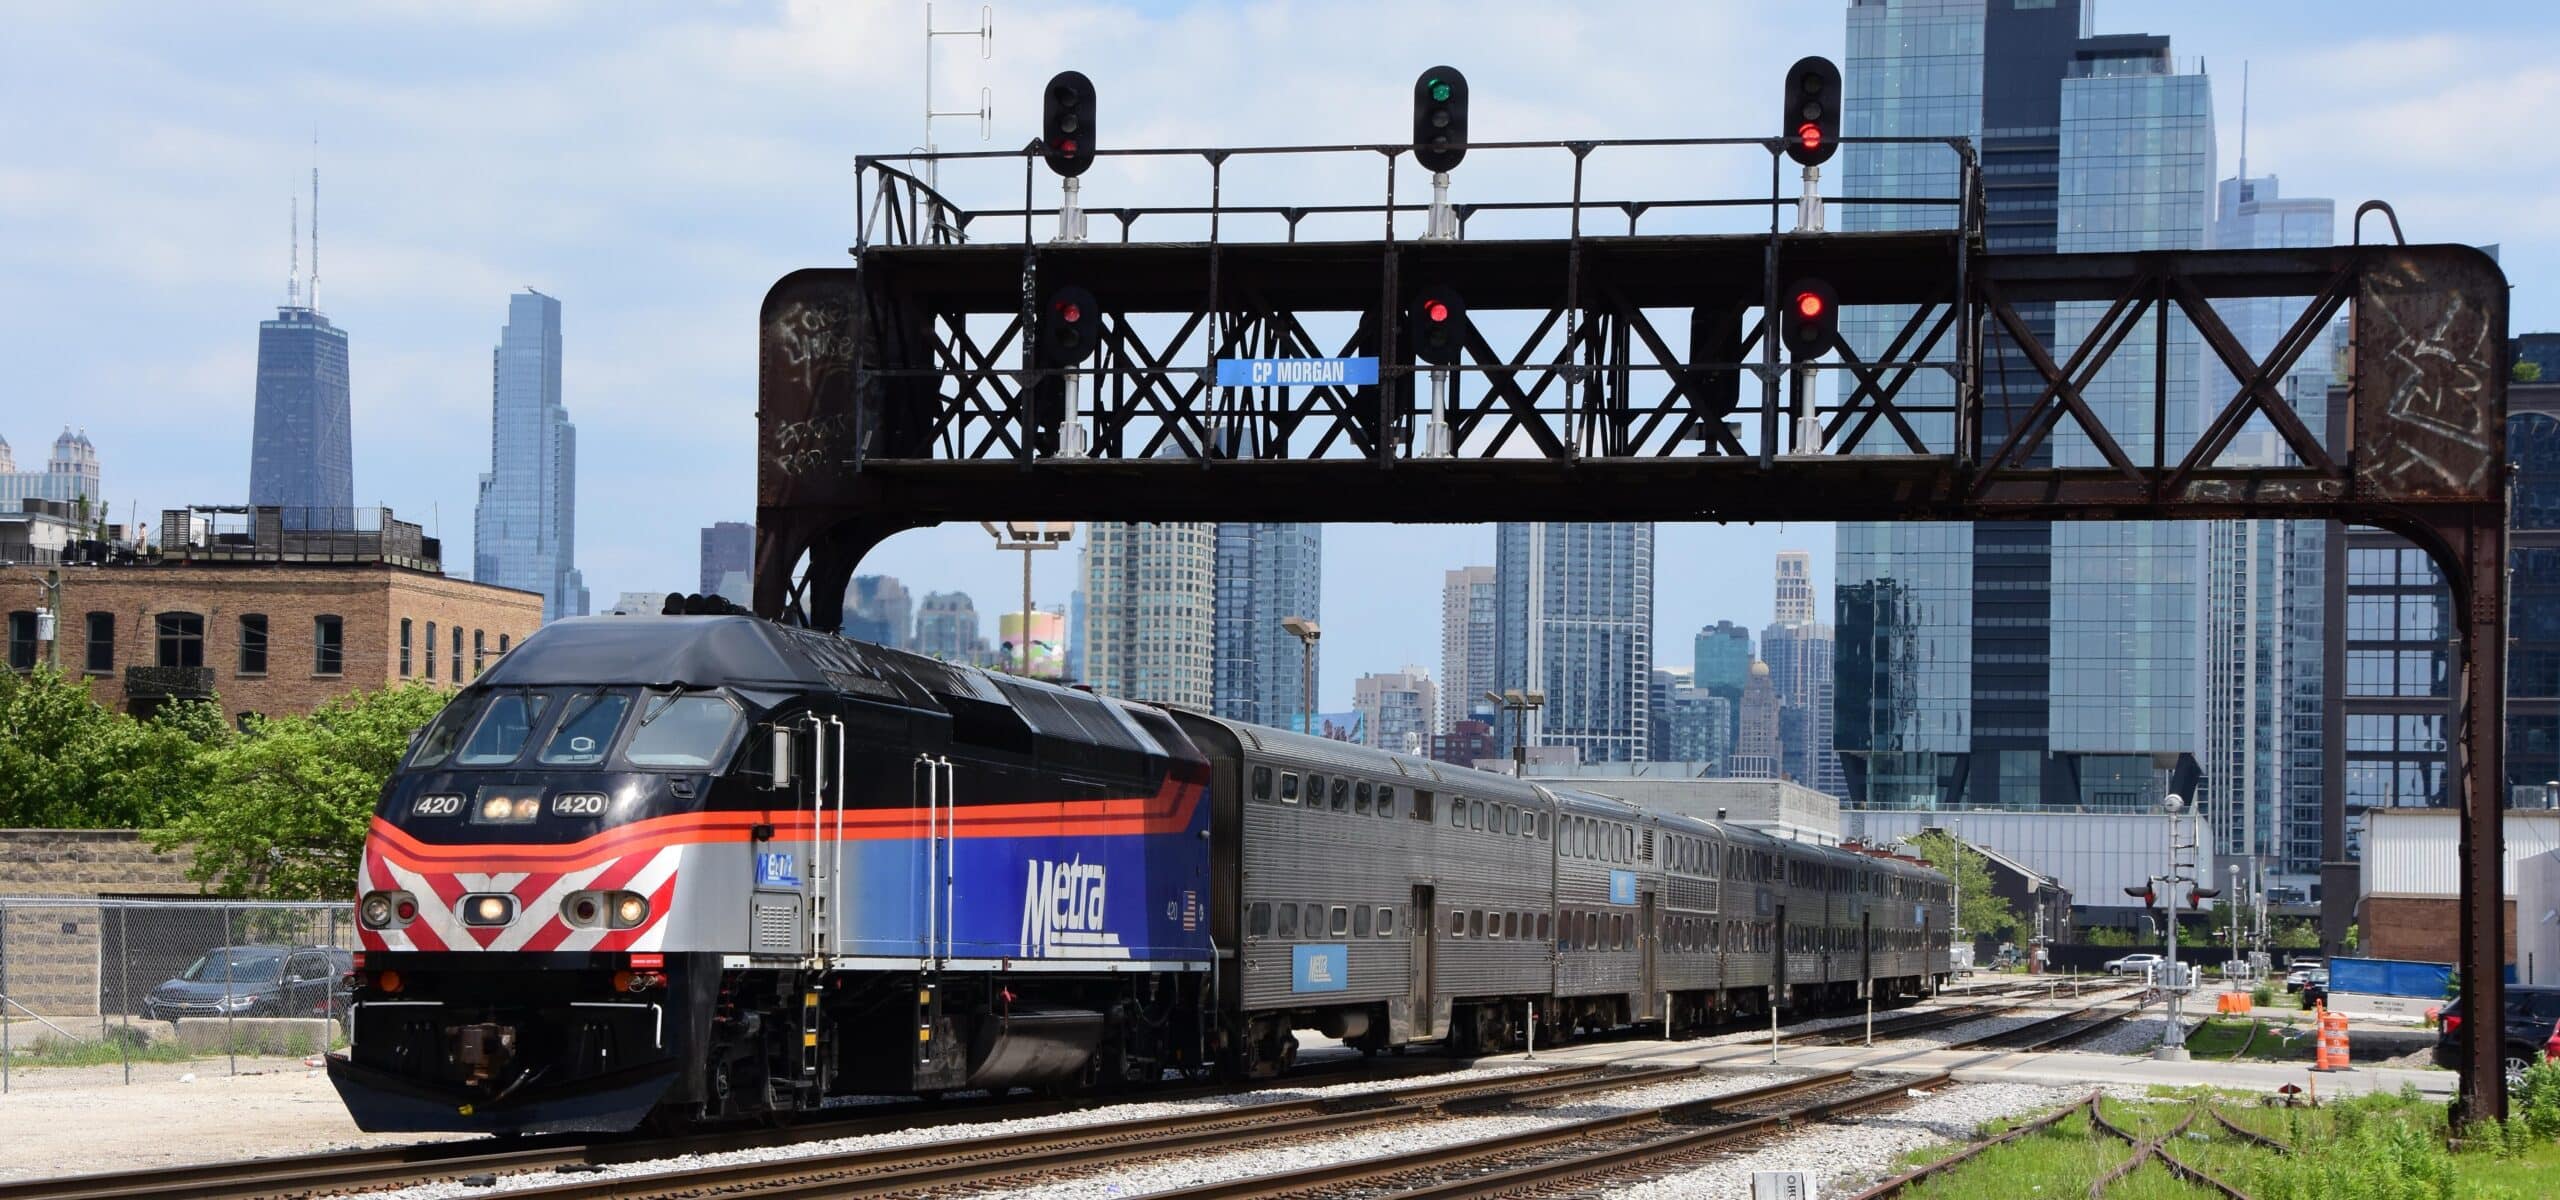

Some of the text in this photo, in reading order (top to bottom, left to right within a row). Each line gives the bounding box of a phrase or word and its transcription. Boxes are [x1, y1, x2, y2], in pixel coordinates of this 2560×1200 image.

[1252, 360, 1344, 383] CP MORGAN
[417, 797, 460, 814] 420
[557, 797, 602, 813] 420
[1020, 852, 1107, 958] Metra
